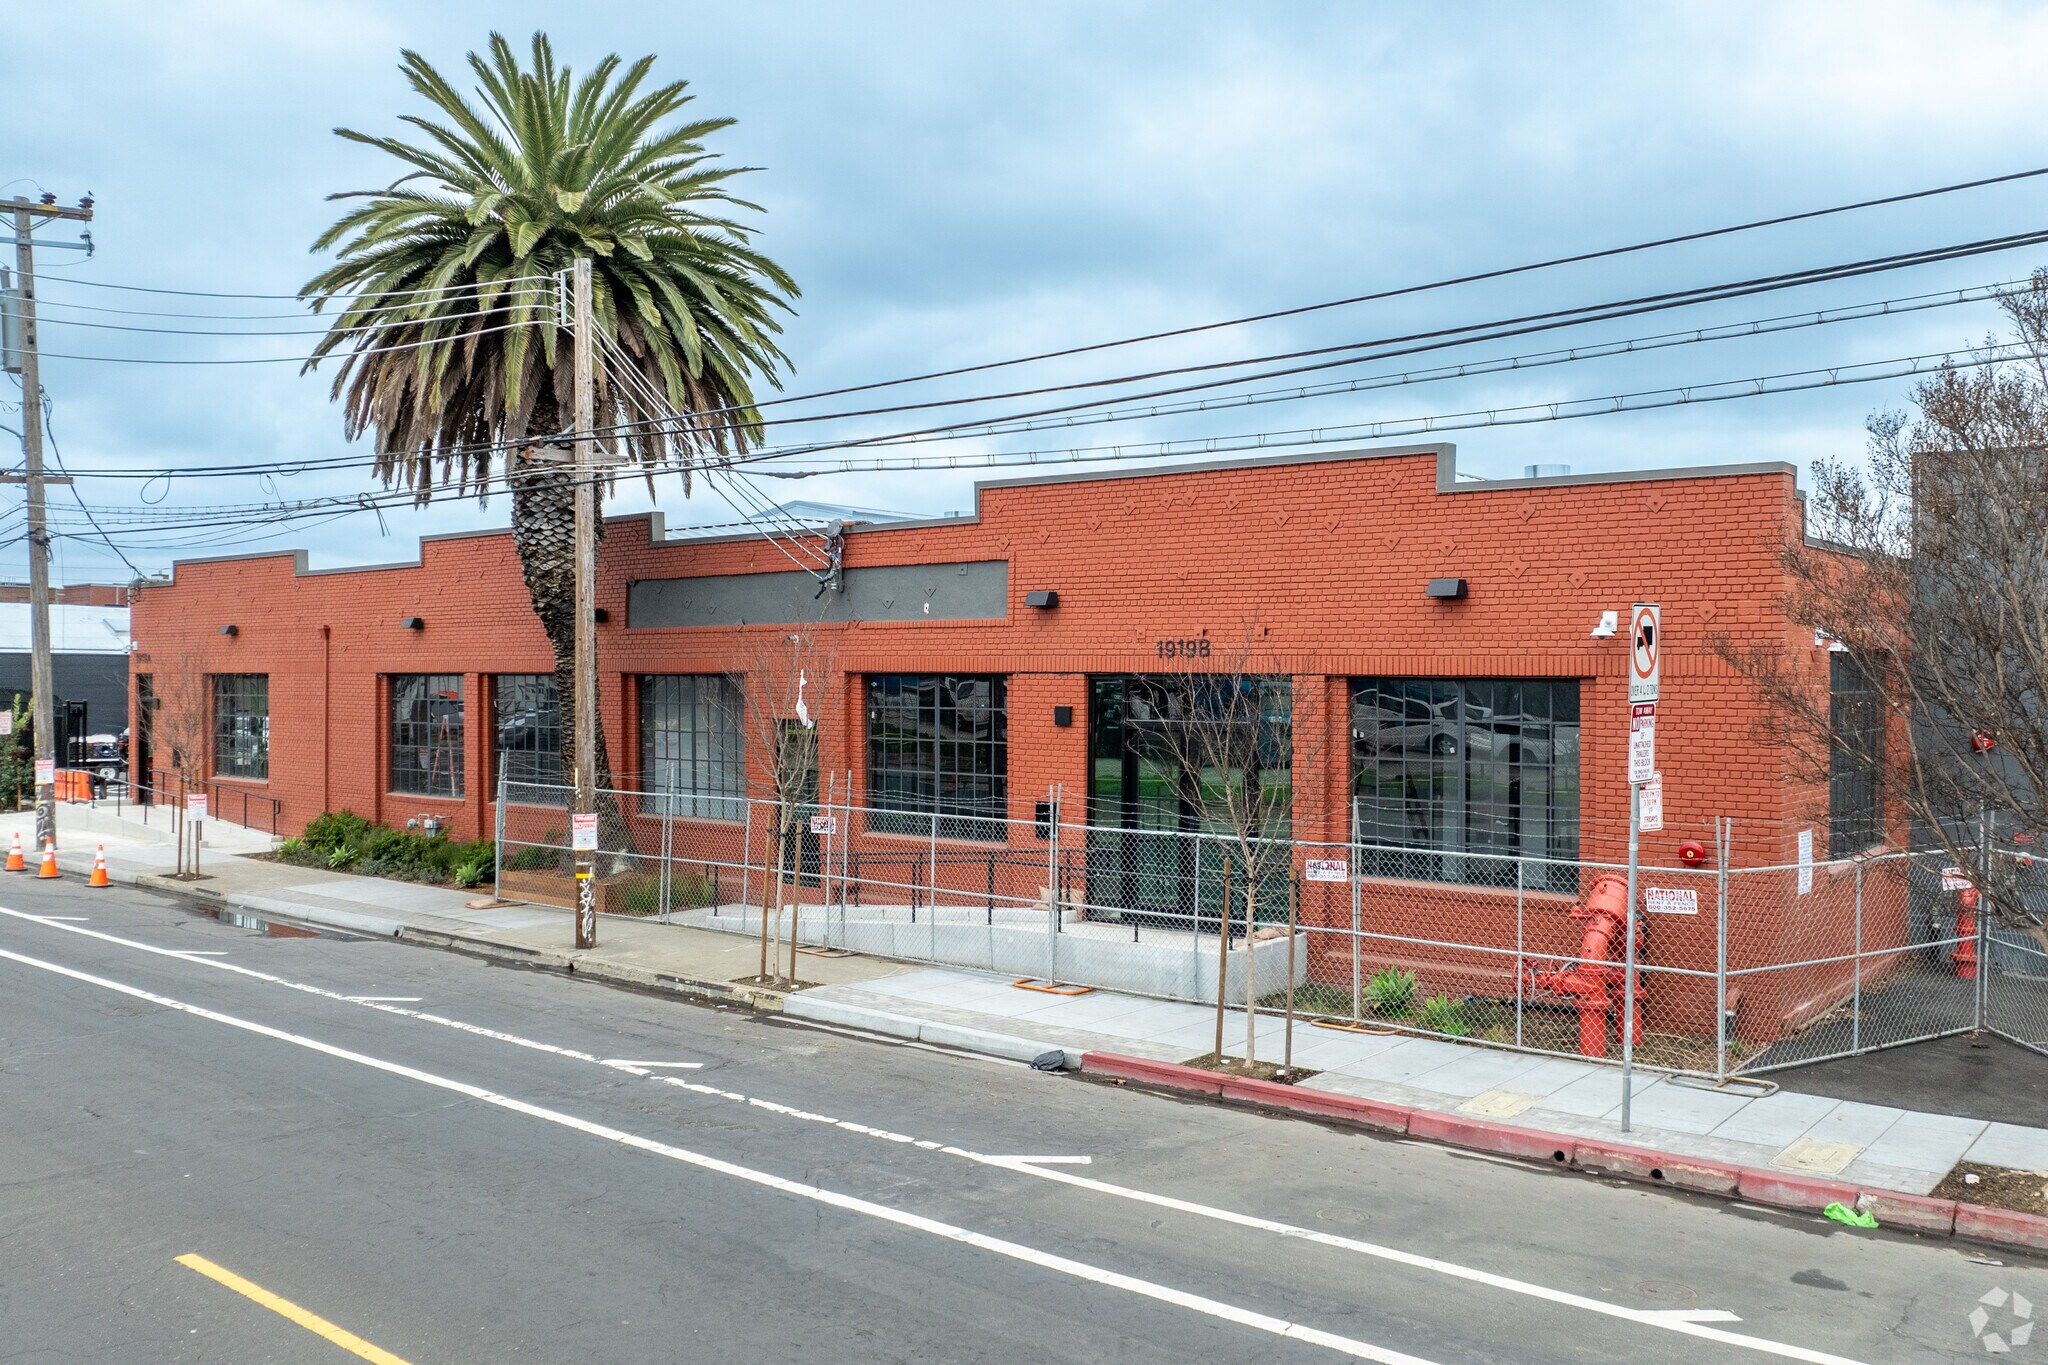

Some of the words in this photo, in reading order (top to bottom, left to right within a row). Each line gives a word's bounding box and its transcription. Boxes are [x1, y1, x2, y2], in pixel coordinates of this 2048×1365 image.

[1157, 639, 1210, 659] 1919B
[1631, 685, 1639, 697] OVER
[1635, 707, 1643, 715] TOW
[1633, 717, 1640, 731] NO
[1640, 718, 1654, 728] PARKING
[1634, 740, 1651, 749] UNATTACHED
[1307, 861, 1346, 871] NATIONAL
[1647, 889, 1695, 902] NATIONAL
